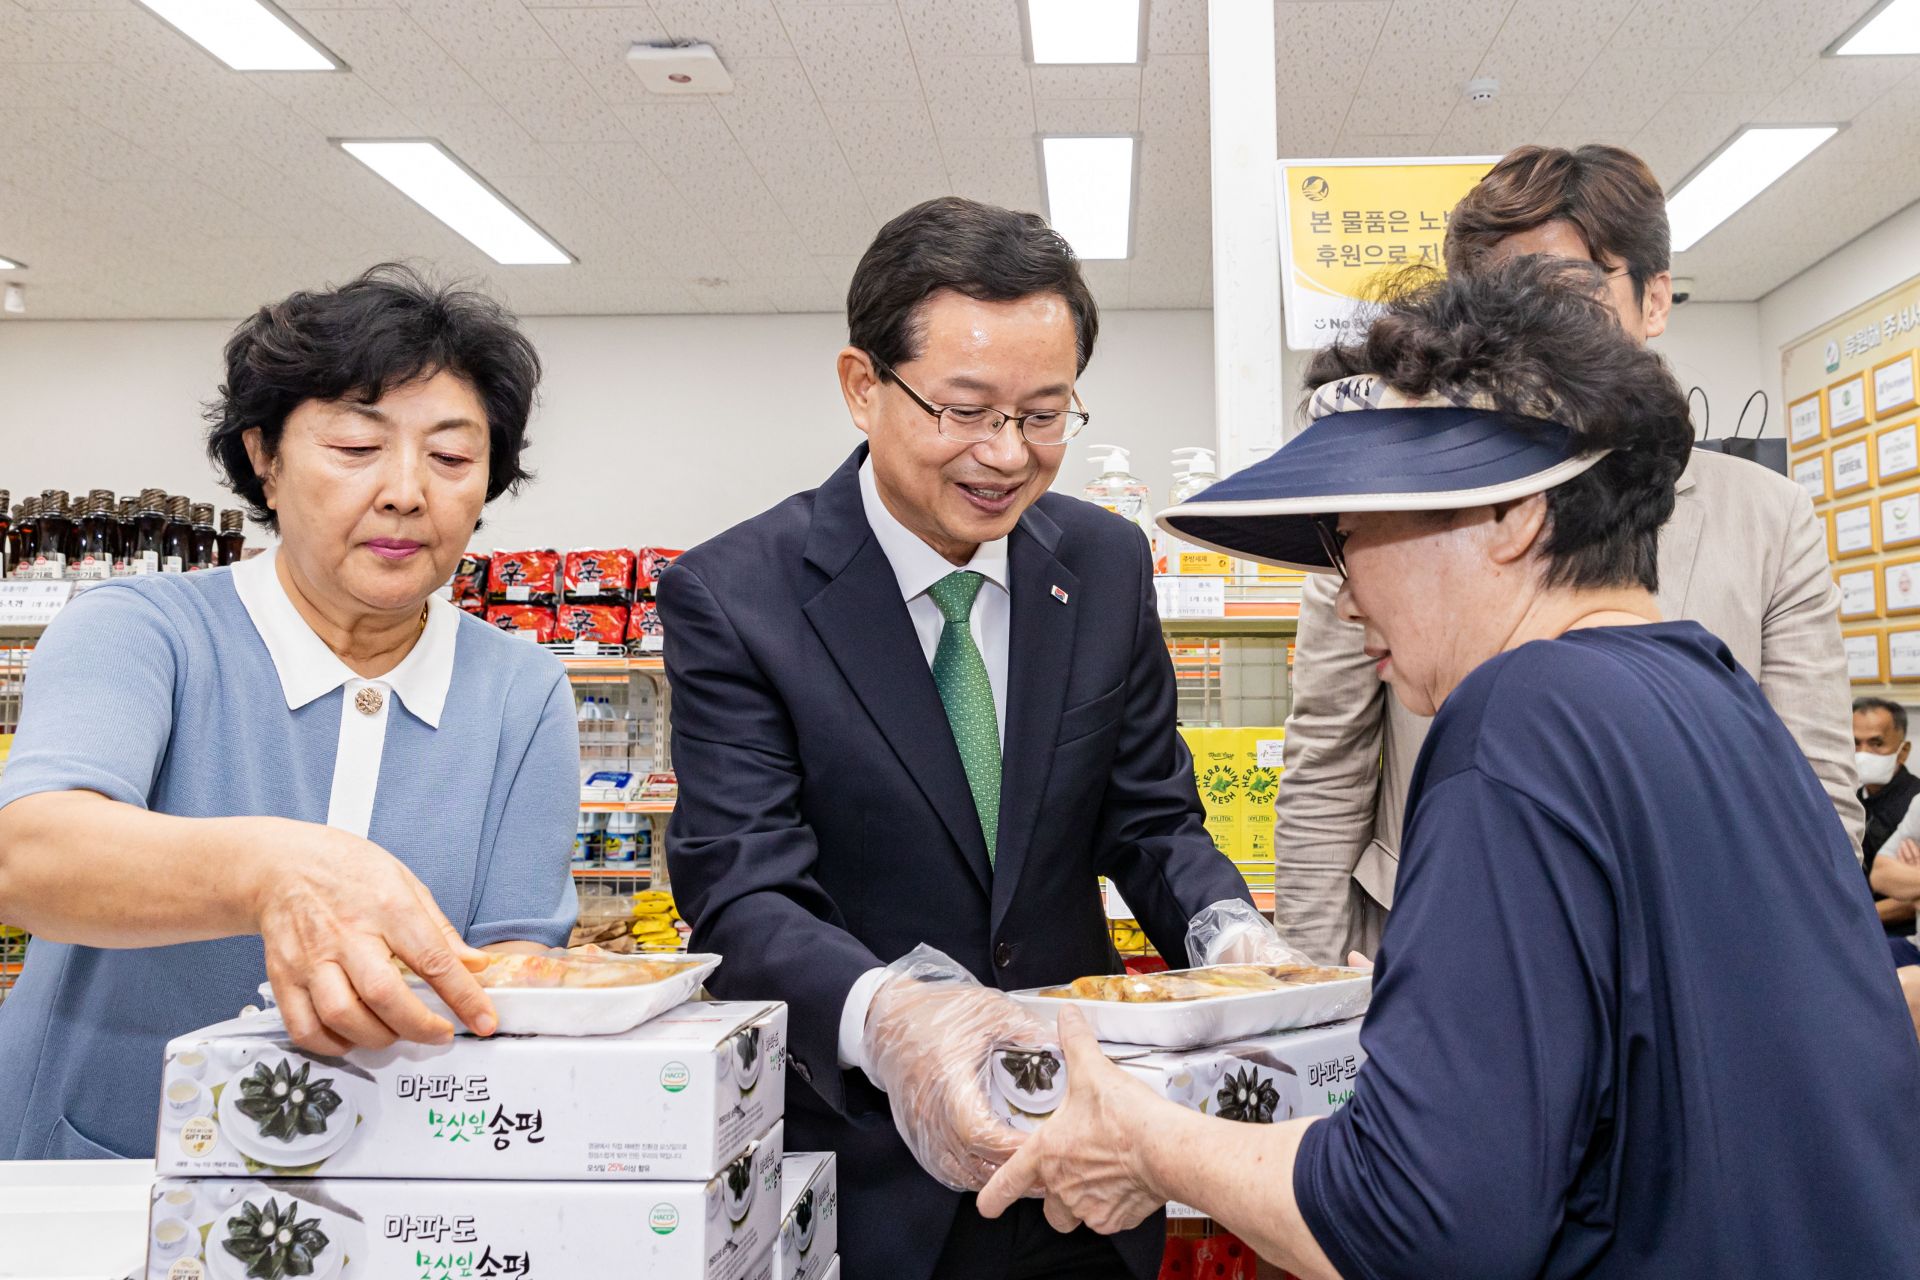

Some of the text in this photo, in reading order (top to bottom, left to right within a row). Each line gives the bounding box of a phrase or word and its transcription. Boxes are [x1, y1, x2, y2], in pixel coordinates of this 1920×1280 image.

[1311, 211, 1332, 233] 본
[1341, 210, 1410, 233] 물품은
[1317, 244, 1409, 268] 후원으로
[499, 561, 526, 586] 辛
[569, 610, 596, 639] 辛
[1203, 765, 1221, 788] HERB
[1223, 765, 1239, 789] MINT
[1242, 765, 1278, 789] HERB MINT
[1206, 792, 1237, 804] FRESH
[1245, 792, 1276, 804] FRESH
[1308, 1055, 1358, 1087] 마파도
[397, 1074, 490, 1102] 마파도
[384, 1215, 477, 1243] 마파도
